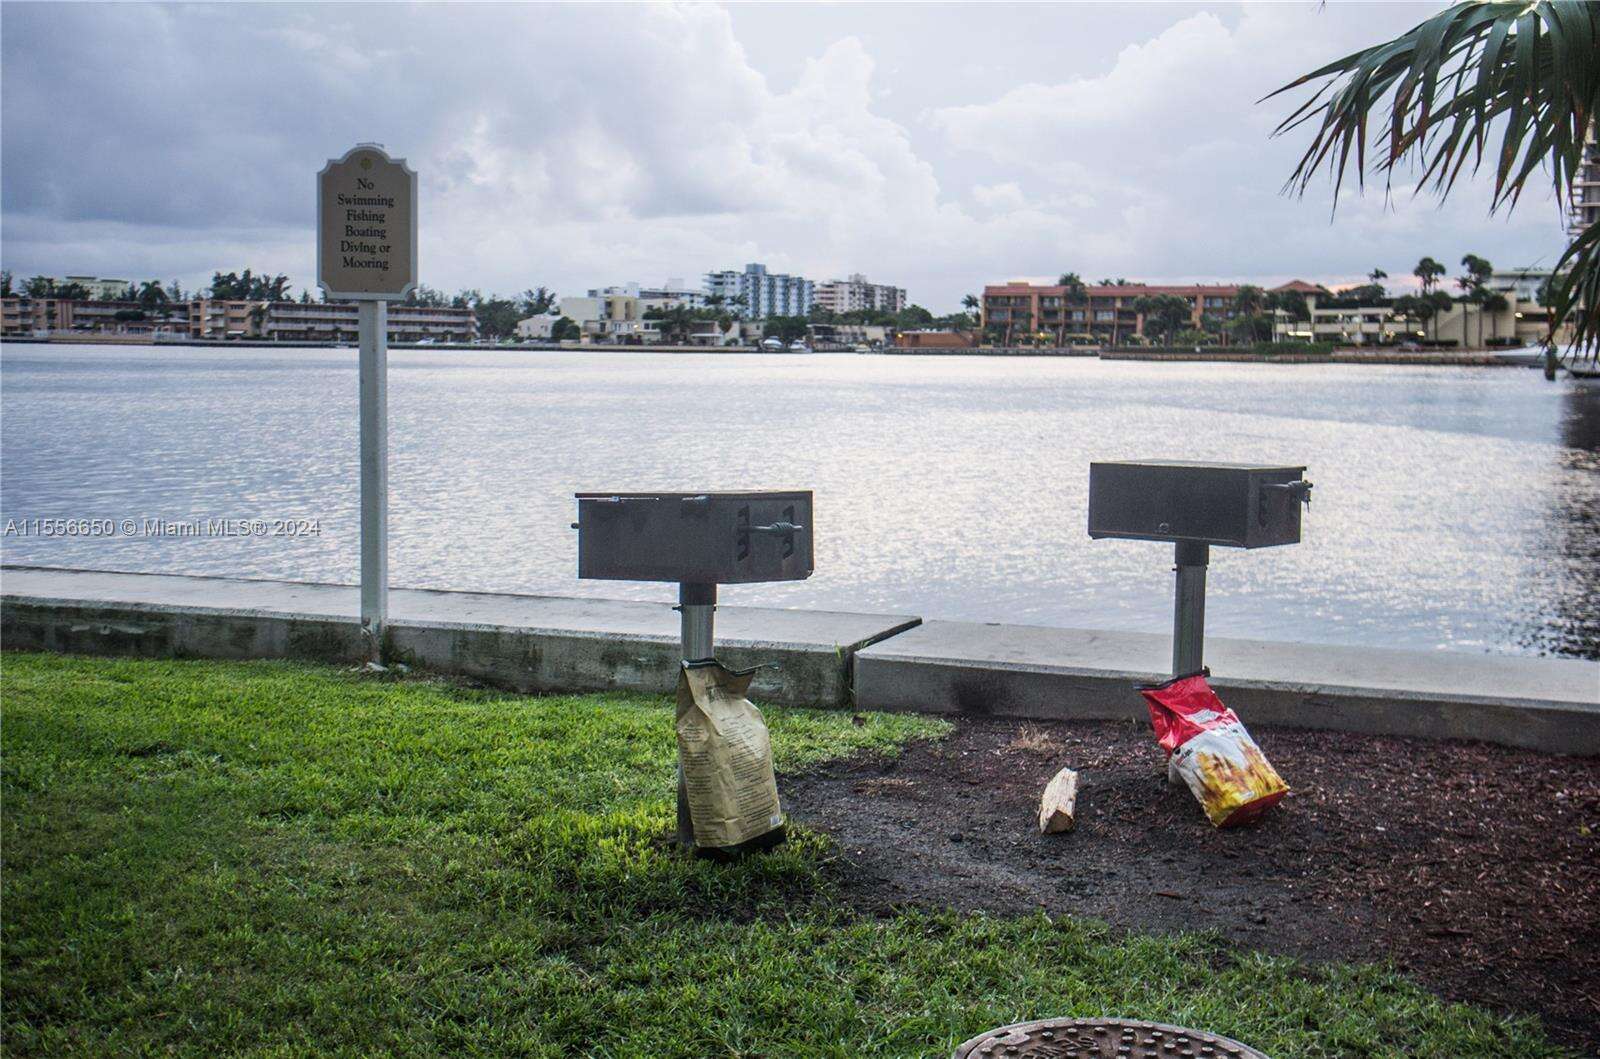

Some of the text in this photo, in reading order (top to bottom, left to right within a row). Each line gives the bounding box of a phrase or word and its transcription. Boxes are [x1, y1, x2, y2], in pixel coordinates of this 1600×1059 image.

[357, 178, 374, 190] No
[337, 193, 394, 208] Swimming
[346, 209, 386, 224] Fishing
[345, 225, 386, 240] Boating
[340, 241, 391, 255] Diving or
[342, 256, 389, 271] Mooring
